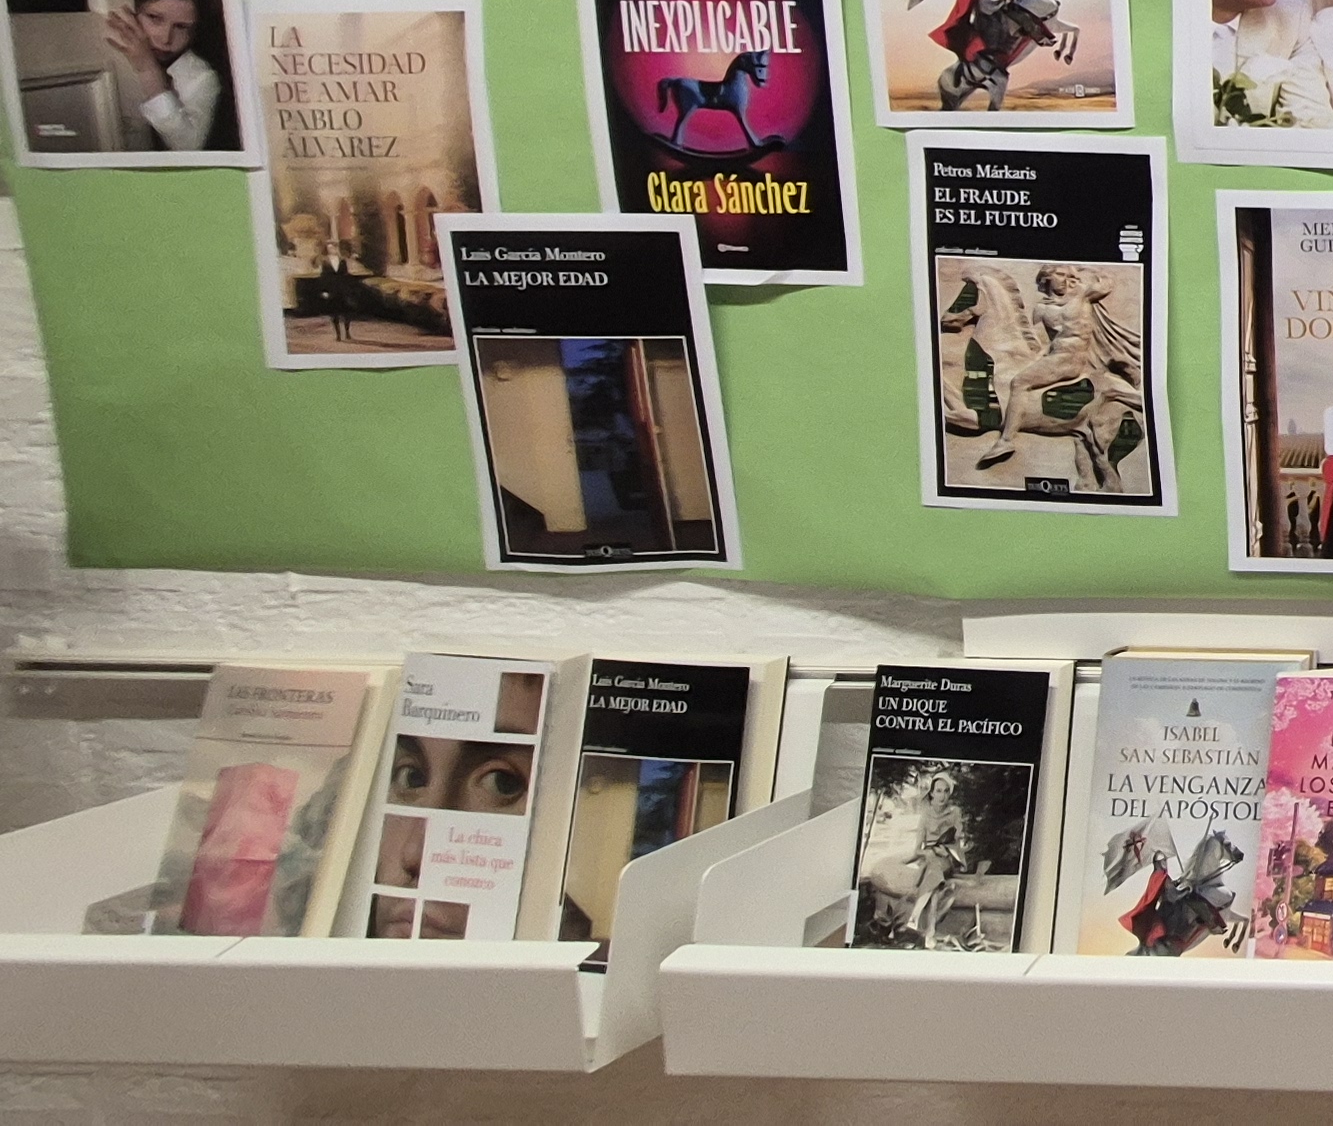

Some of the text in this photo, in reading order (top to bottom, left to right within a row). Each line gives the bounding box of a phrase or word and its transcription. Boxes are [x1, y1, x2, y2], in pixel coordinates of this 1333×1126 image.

[620, 0, 802, 54] INEXPLICABLE
[271, 52, 426, 75] NECESIDAD
[278, 109, 362, 130] PABLO
[283, 133, 399, 158] ÁLVAREZ
[933, 162, 1037, 181] Petros Márkaris
[648, 172, 812, 215] Clara Sánchez
[464, 271, 608, 290] LA MEJOR EDAD
[876, 716, 1022, 735] CONTRA EL PACÍFICO
[1163, 726, 1220, 742] ISABEL
